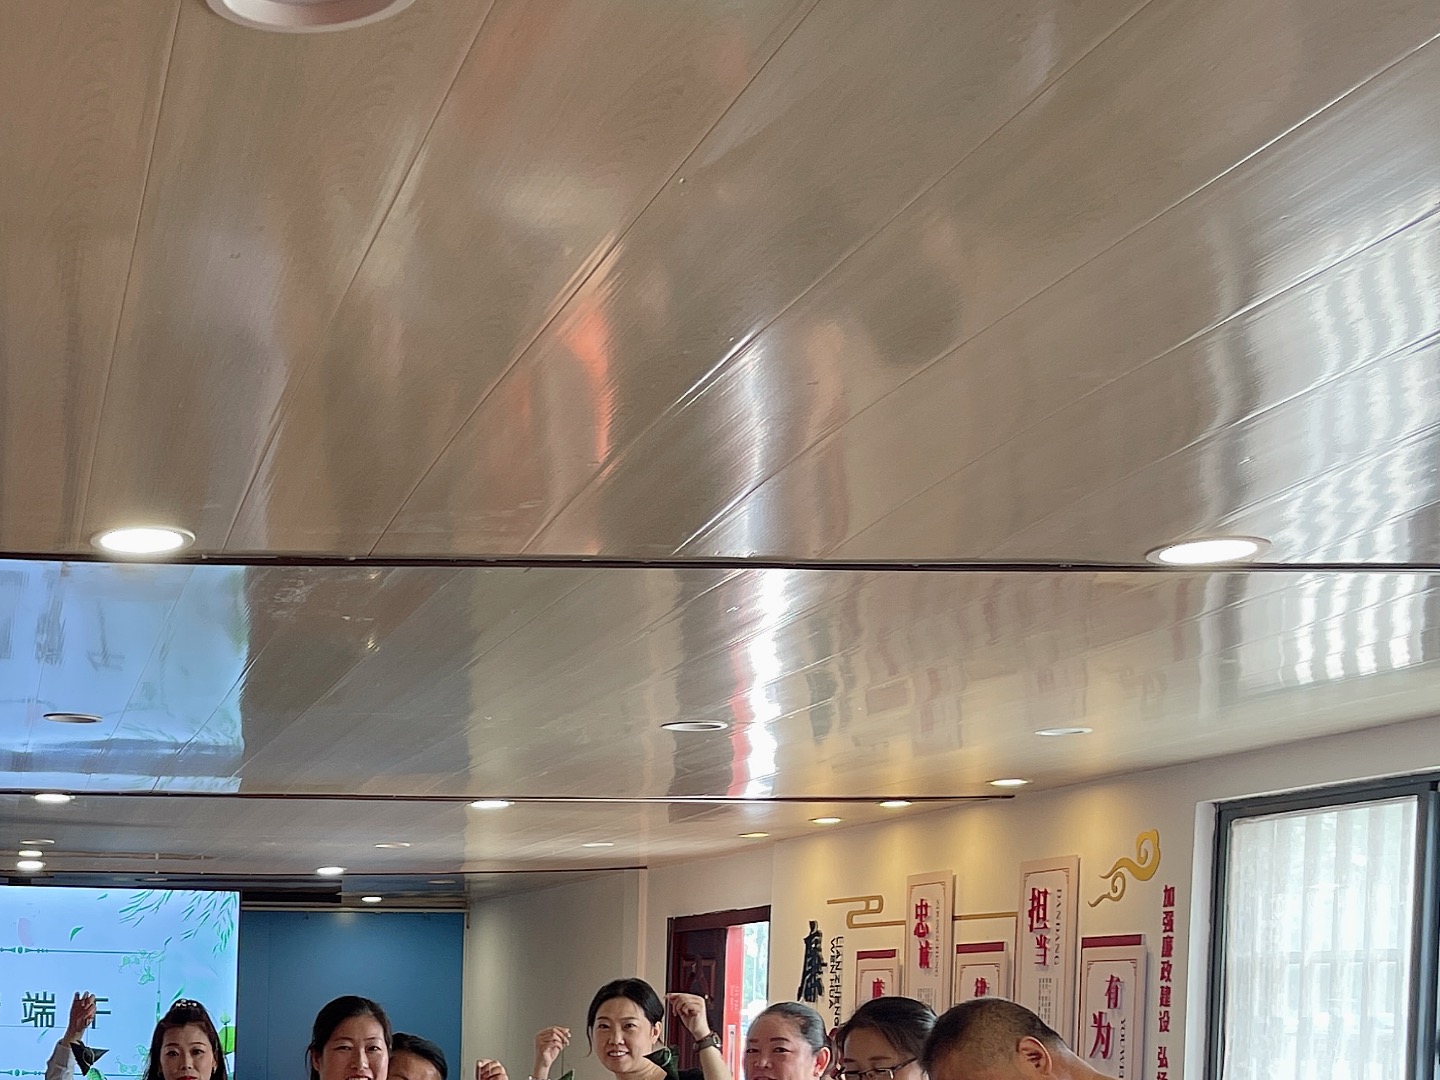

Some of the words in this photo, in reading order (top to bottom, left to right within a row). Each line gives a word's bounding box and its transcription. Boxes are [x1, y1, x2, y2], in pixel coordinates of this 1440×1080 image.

[835, 936, 844, 971] LIAN
[1028, 887, 1051, 967] 担当
[1159, 884, 1175, 1033] 加强廉政建设
[833, 975, 842, 1027] ZHENG
[1089, 974, 1124, 1060] 有为
